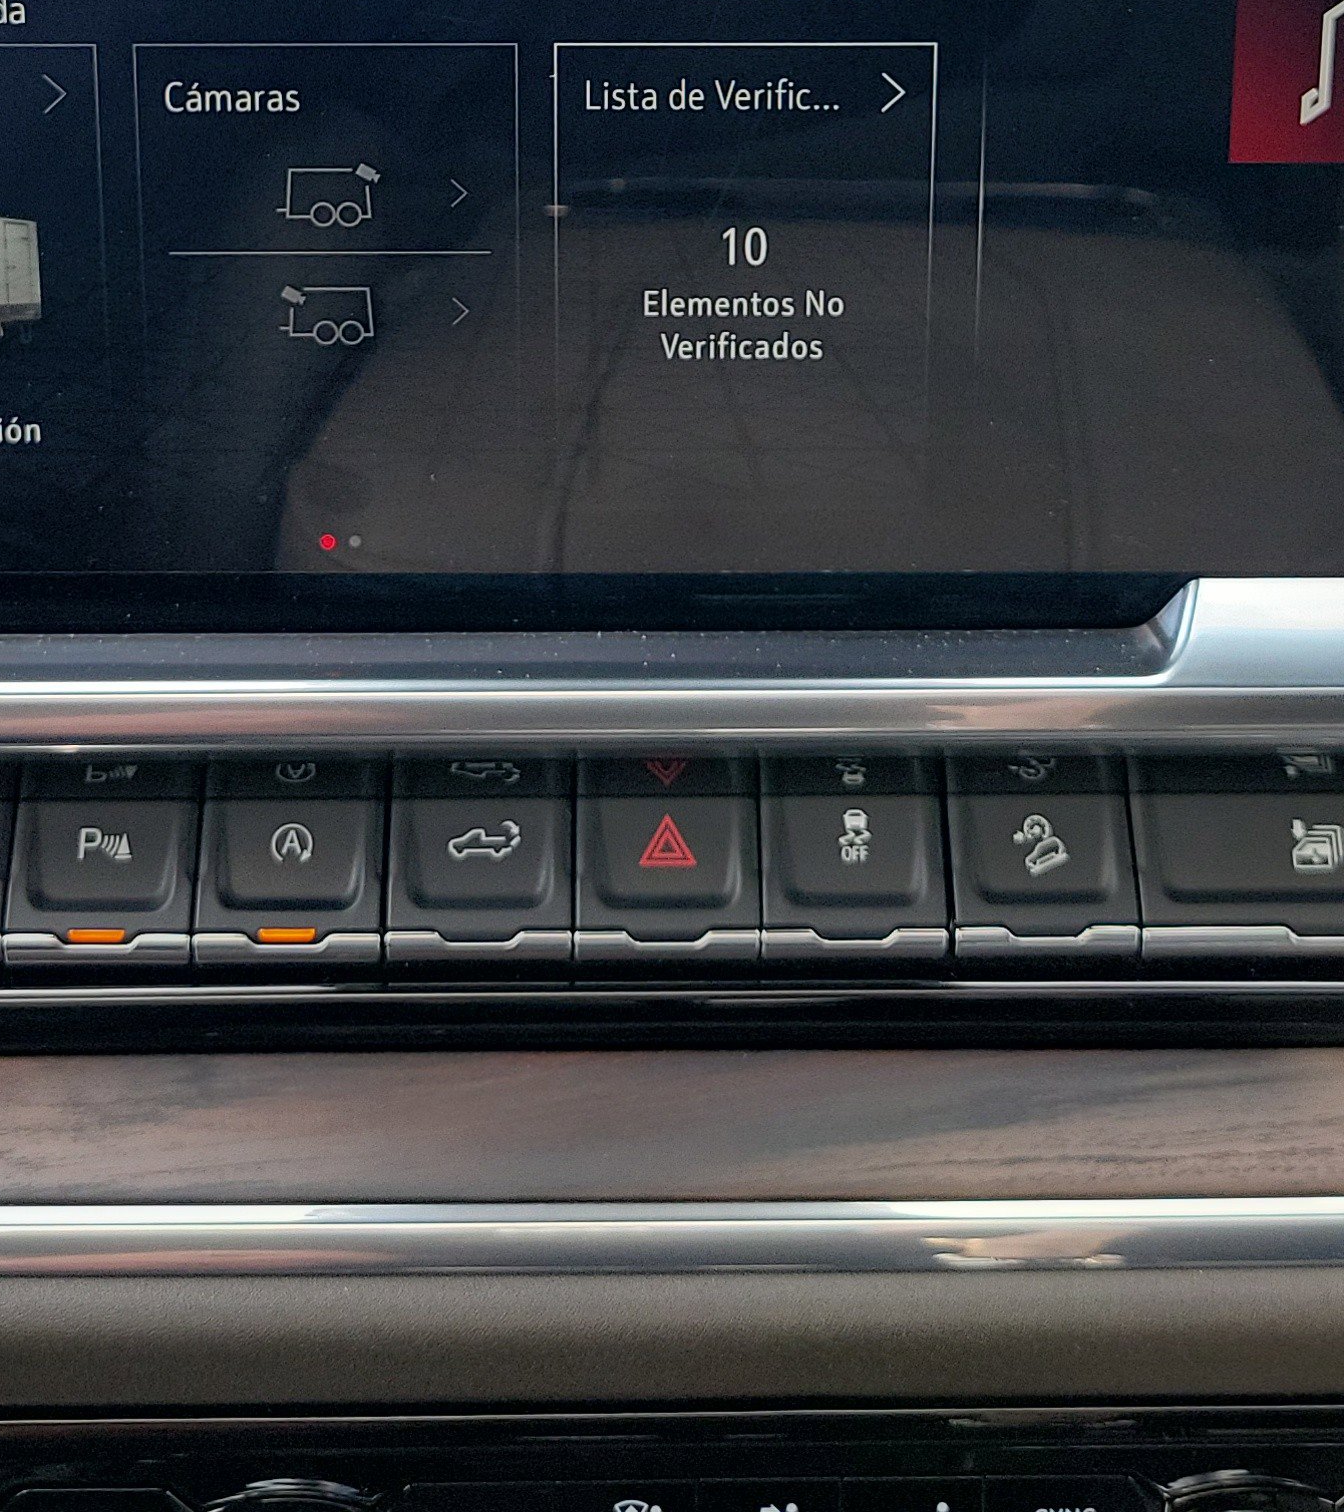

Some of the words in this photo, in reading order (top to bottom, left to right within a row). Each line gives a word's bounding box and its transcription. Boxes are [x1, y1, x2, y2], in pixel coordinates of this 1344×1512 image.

[164, 81, 301, 113] Cámaras
[585, 79, 658, 111] Lista
[668, 78, 705, 111] de
[722, 227, 768, 266] 10
[643, 288, 795, 317] Elementos
[805, 289, 844, 317] No
[660, 331, 823, 360] Verificados
[77, 827, 102, 860] P
[281, 828, 303, 855] A
[840, 844, 870, 863] OFF
